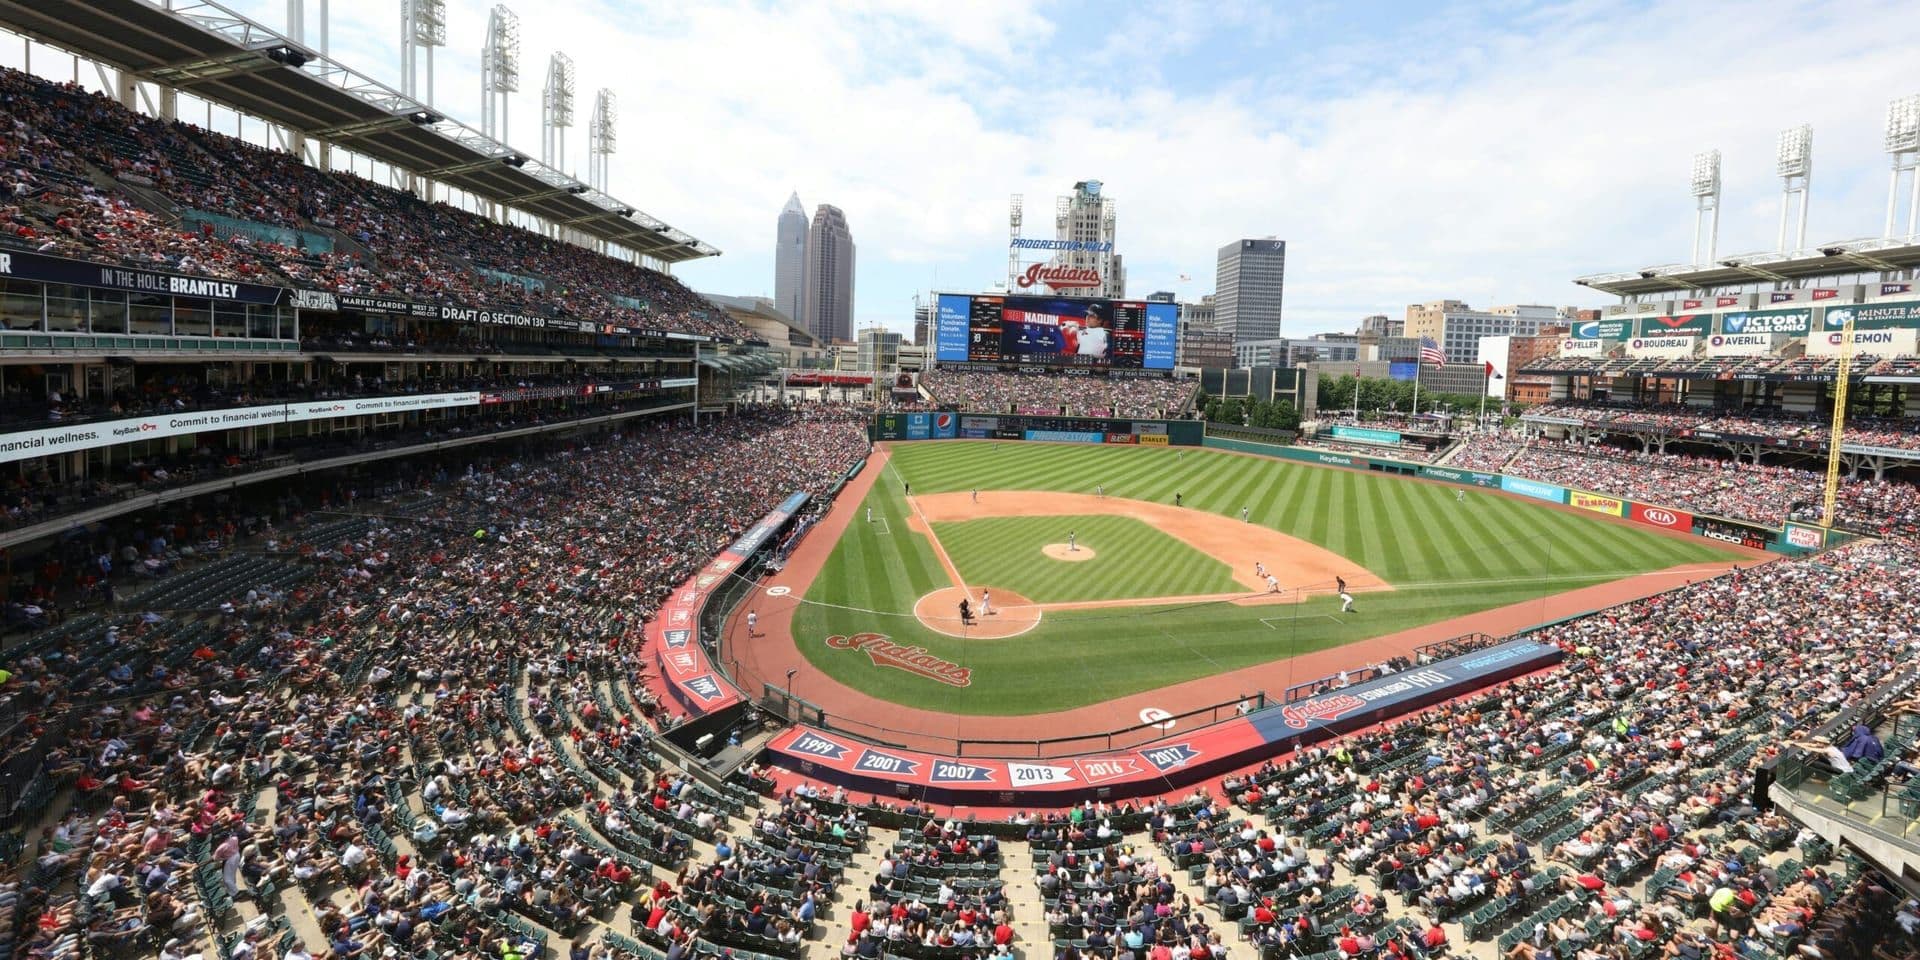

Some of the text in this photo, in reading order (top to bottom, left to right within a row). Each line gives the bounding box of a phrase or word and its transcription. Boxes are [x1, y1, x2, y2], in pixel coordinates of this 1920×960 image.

[1010, 238, 1081, 251] PROGRESSIVE
[102, 268, 238, 299] IN THE HOLE: BRANTLEY
[1017, 263, 1101, 289] Indians
[1884, 285, 1900, 293] 1998
[342, 298, 375, 308] MARKET
[377, 302, 407, 310] GARDEN
[442, 307, 545, 328] DRAFT @ SECTION 130
[1024, 311, 1059, 326] NAQUIN
[1857, 307, 1906, 318] MINUTE
[1728, 314, 1809, 332] VICTORY
[1742, 324, 1807, 333] PARK OHIO
[1573, 341, 1598, 349] FELLER
[1643, 339, 1688, 348] BOUDREAU
[1725, 336, 1766, 346] AVERILL
[1853, 333, 1892, 343] EMON
[356, 401, 383, 410] Commit
[170, 407, 299, 429] Commit to financial wellness.
[113, 426, 141, 436] KeyBank
[1031, 430, 1094, 441] PROGRESSIVE
[0, 430, 100, 453] nancial wellness.
[1319, 454, 1352, 465] KeyBank
[1649, 510, 1671, 523] KIA
[1704, 530, 1742, 544] NOCO
[1790, 526, 1816, 541] drug
[674, 653, 694, 667] 1997
[825, 632, 973, 687] Indians
[690, 678, 717, 694] 1998
[1357, 669, 1453, 700] ESTABLISHED 1901
[1281, 694, 1367, 729] Indians
[798, 736, 836, 755] 1999
[863, 754, 902, 773] 2001
[1149, 747, 1184, 766] 2017
[938, 763, 976, 781] 2007
[1015, 766, 1055, 782] 2013
[1085, 760, 1123, 777] 2016
